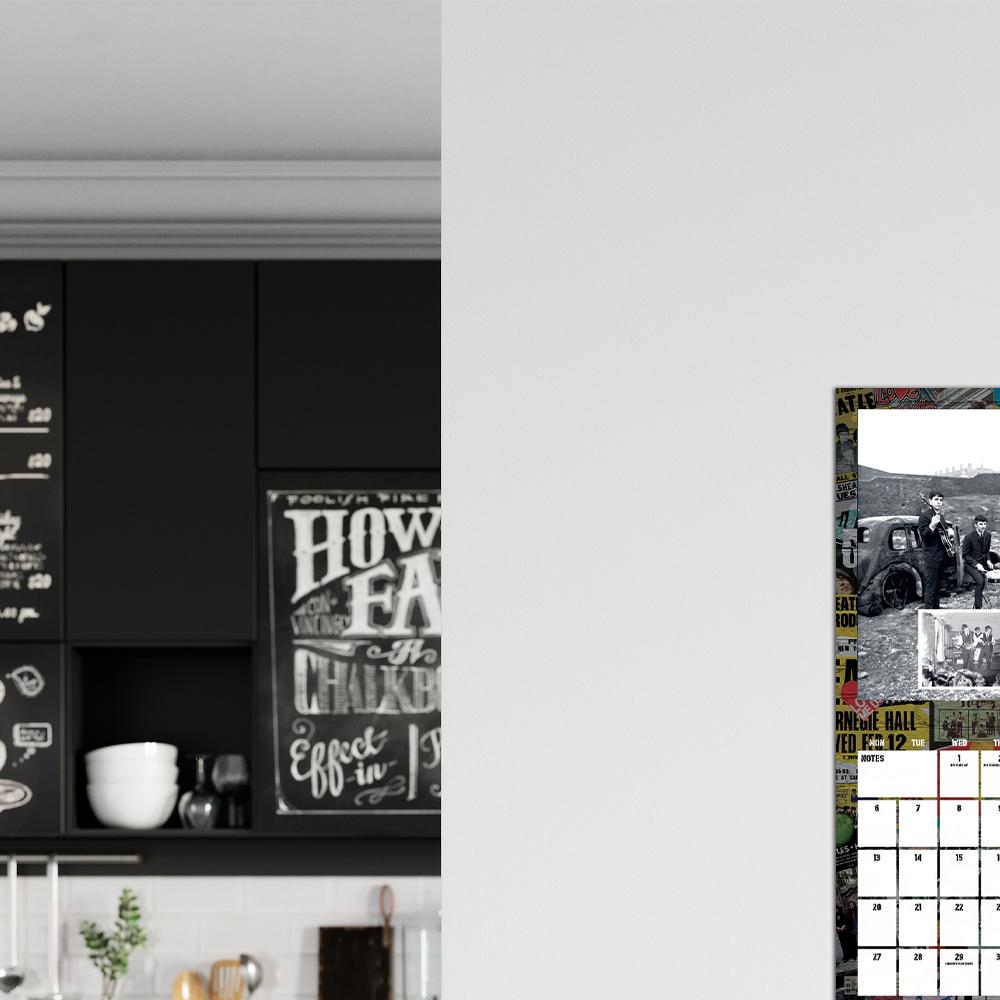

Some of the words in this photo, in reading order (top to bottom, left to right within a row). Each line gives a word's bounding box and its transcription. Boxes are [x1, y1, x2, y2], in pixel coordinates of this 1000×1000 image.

[284, 507, 441, 604] HOW
[294, 648, 441, 715] CHALKB
[885, 710, 917, 731] HALL
[911, 738, 926, 748] TUE
[951, 738, 968, 747] WED
[860, 753, 885, 763] NOTES
[874, 804, 880, 813] 6
[915, 804, 921, 813] 7
[956, 804, 962, 813] 8
[873, 853, 881, 862] 13
[914, 853, 922, 862] 14
[955, 853, 963, 862] 15
[872, 903, 882, 912] 20
[914, 903, 922, 912] 21
[954, 903, 964, 912] 22
[872, 952, 882, 961] 27
[913, 952, 923, 961] 28
[954, 952, 964, 961] 29
